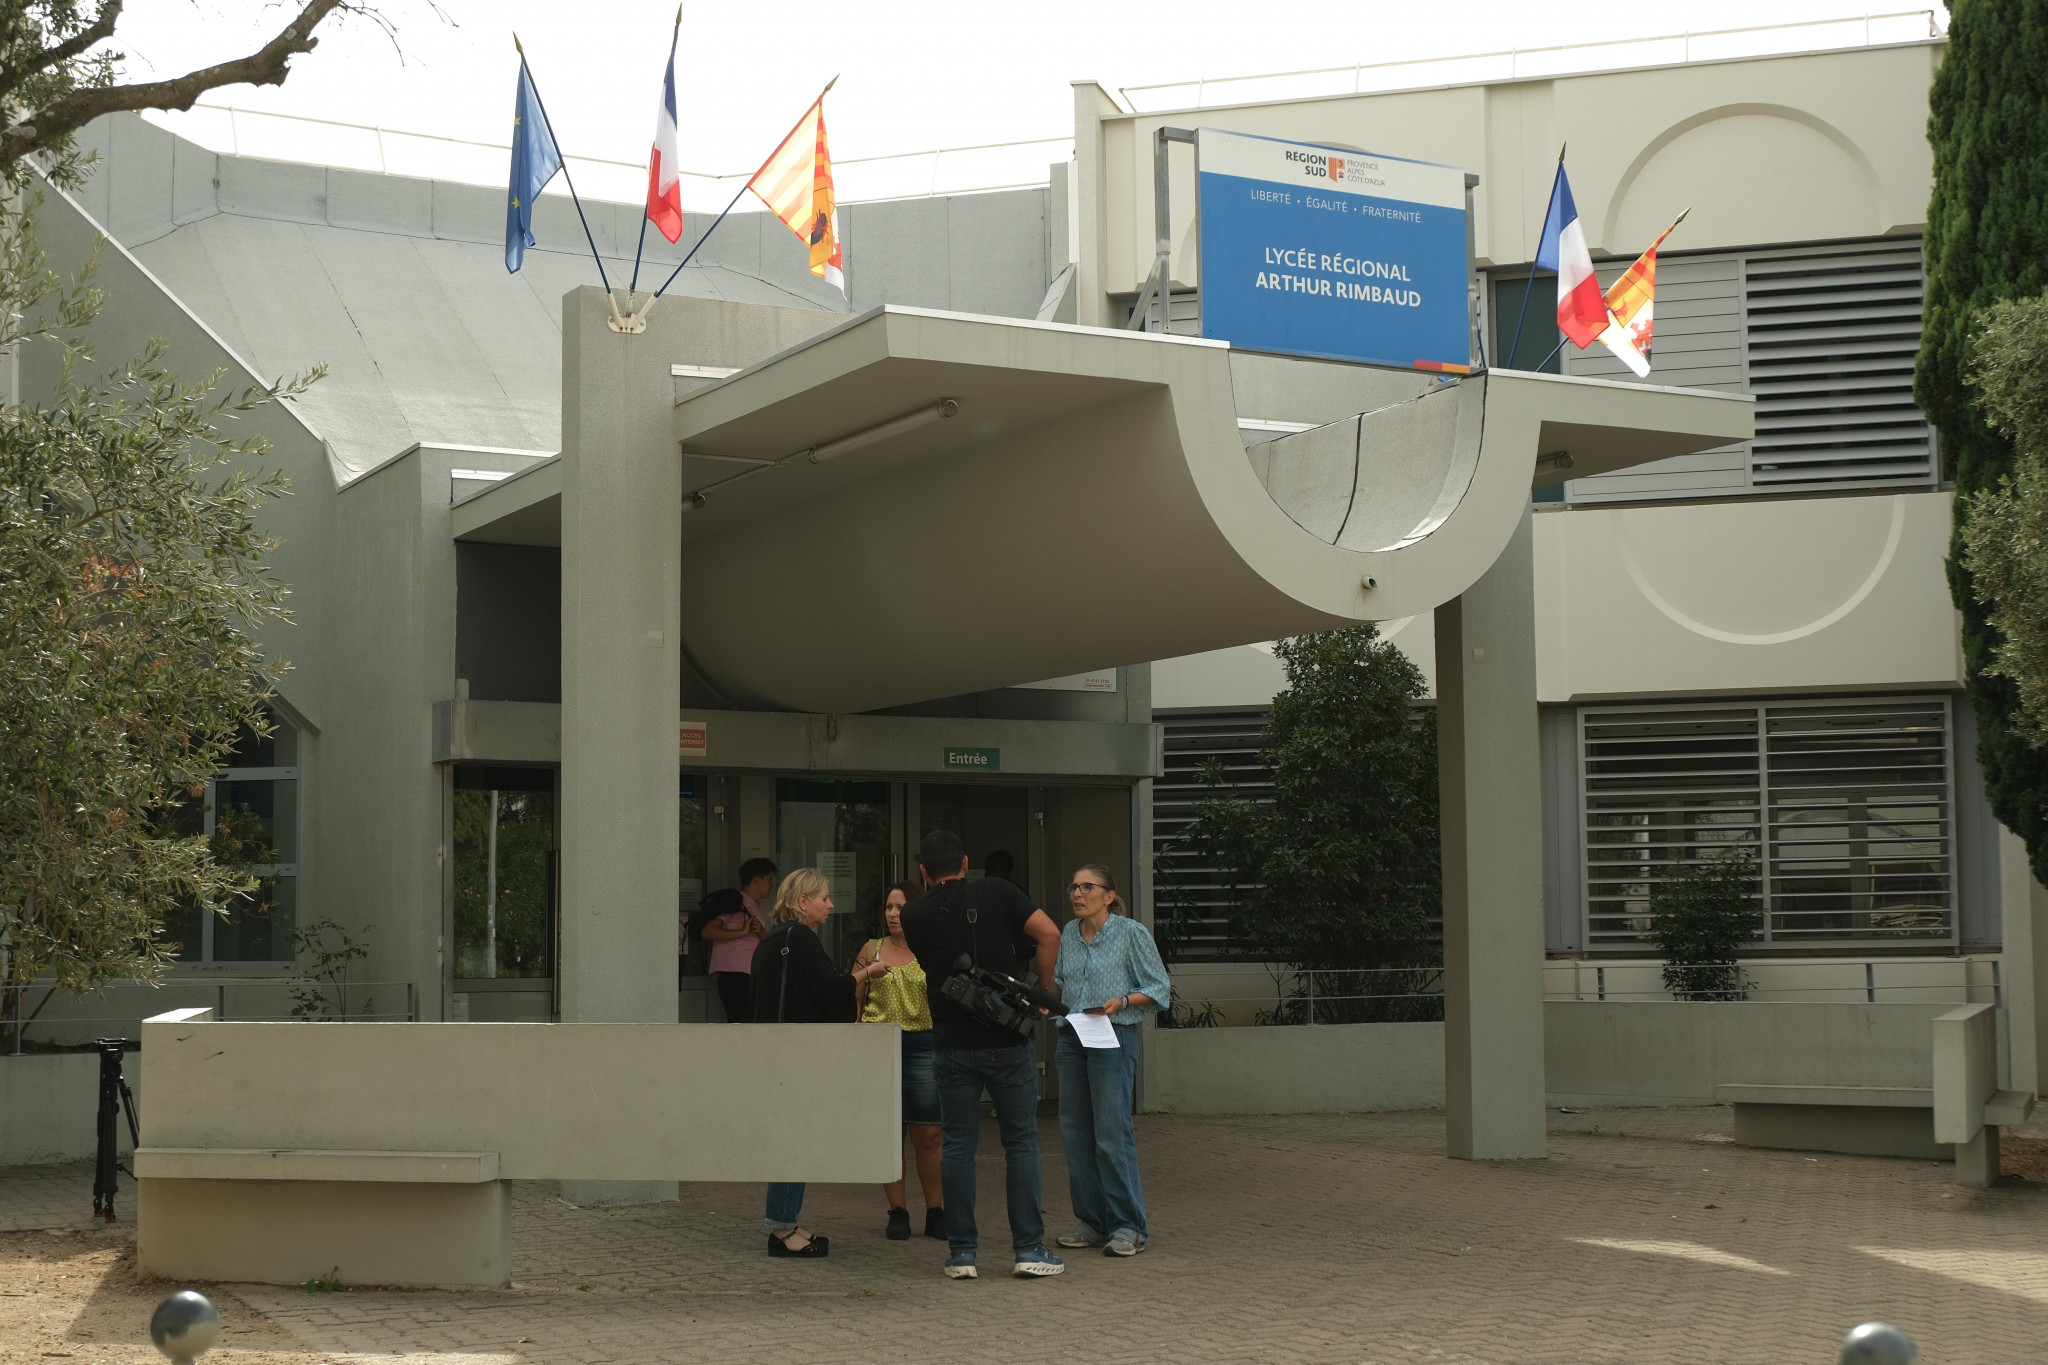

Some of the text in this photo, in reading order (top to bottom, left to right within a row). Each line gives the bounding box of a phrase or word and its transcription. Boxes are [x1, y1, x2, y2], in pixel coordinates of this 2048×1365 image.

[1304, 165, 1327, 178] SUD
[1347, 159, 1379, 171] PROVENCE
[1347, 168, 1365, 176] ALPES
[1347, 174, 1363, 184] CÔTE
[1250, 189, 1421, 223] LIBERTÉ ÉGALITÉ FRATERNITÉ
[1265, 247, 1411, 282] LYCÉE RÉGIONAL
[1256, 271, 1421, 307] ARTHUR RIMBAUD
[949, 752, 988, 765] Entrée
